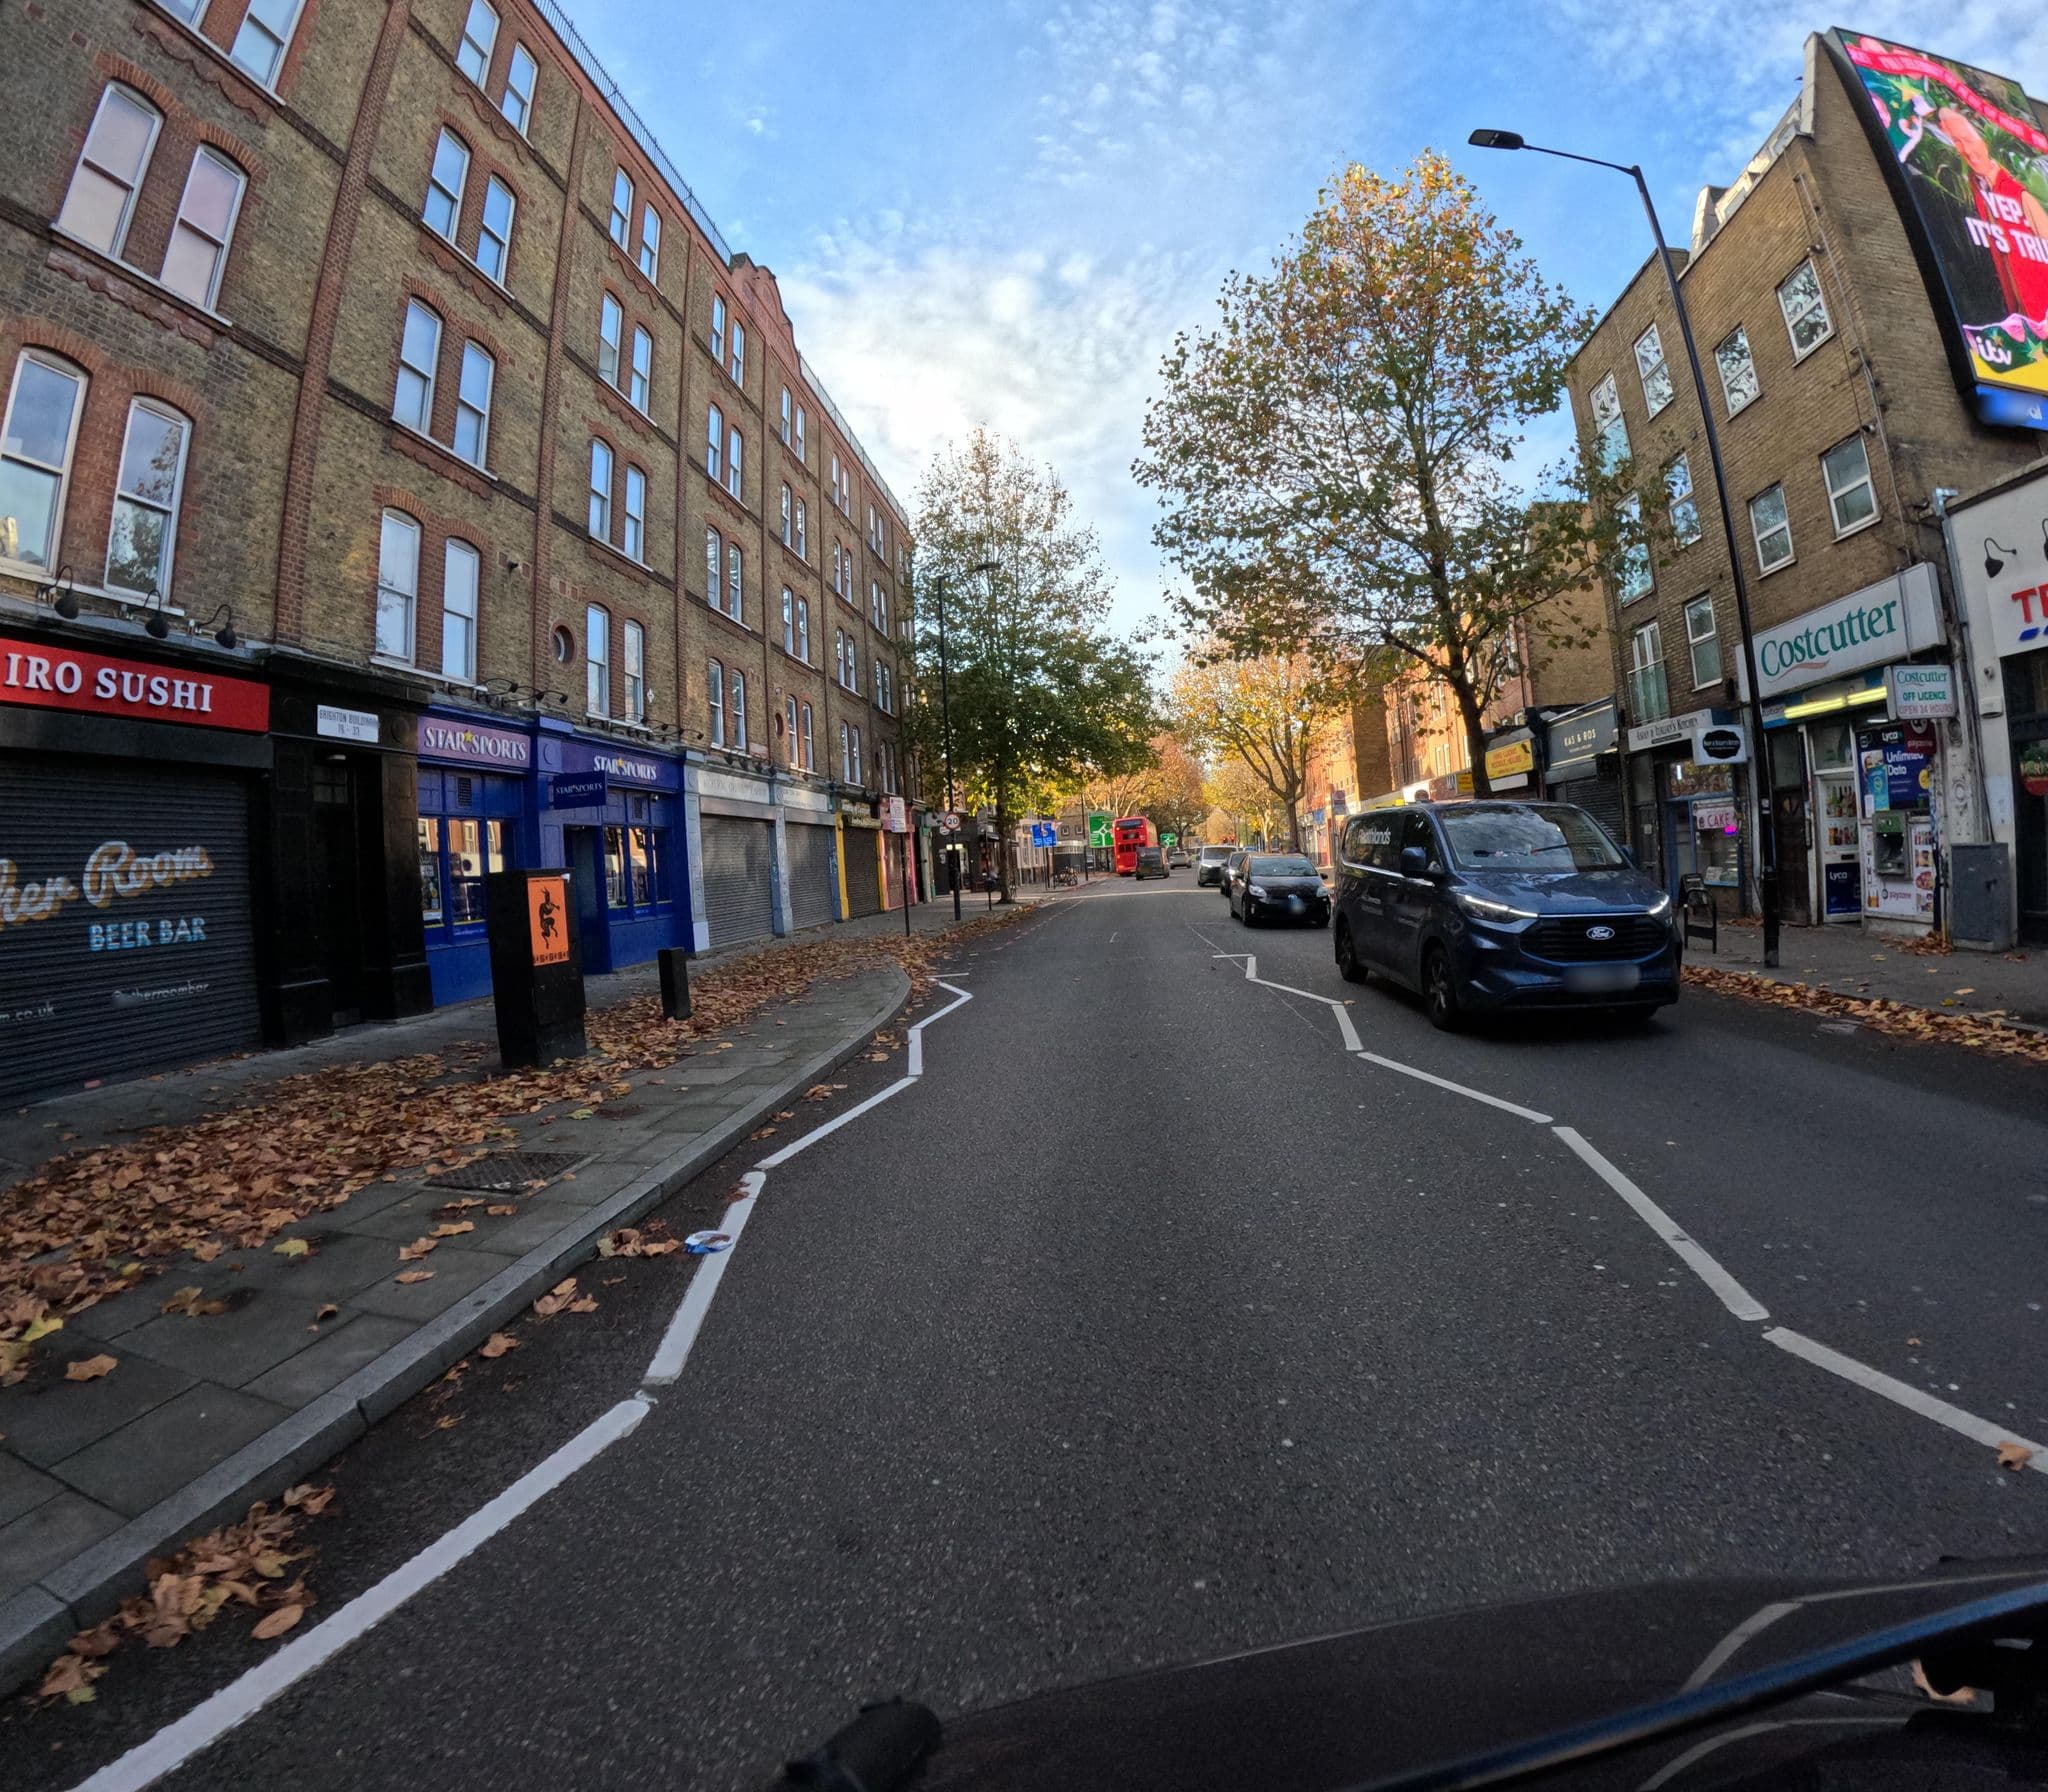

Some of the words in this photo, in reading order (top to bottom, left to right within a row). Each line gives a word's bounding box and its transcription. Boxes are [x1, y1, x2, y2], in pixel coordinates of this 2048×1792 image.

[1965, 216, 2011, 254] IT'S
[1976, 335, 2012, 366] itv
[1761, 600, 1898, 678] Costcutter
[4, 652, 83, 694] IRO
[95, 668, 213, 712] SUSHI
[1896, 670, 1948, 684] Costcutter
[1902, 692, 1916, 701] OFF
[1918, 690, 1947, 701] LICENCE
[1900, 704, 1918, 714] OPEN
[1928, 704, 1952, 713] HOURS
[424, 726, 466, 751] STAR
[470, 733, 526, 761] SPORTS
[594, 755, 620, 775] STAR
[621, 760, 657, 780] SPORTS
[1888, 764, 1907, 776] Data
[555, 785, 573, 795] STAR
[575, 782, 603, 793] SPORTS
[948, 817, 958, 825] 20
[1707, 812, 1730, 827] CAKE
[83, 841, 213, 906] Room
[88, 921, 151, 951] BEER
[158, 916, 208, 944] BAR
